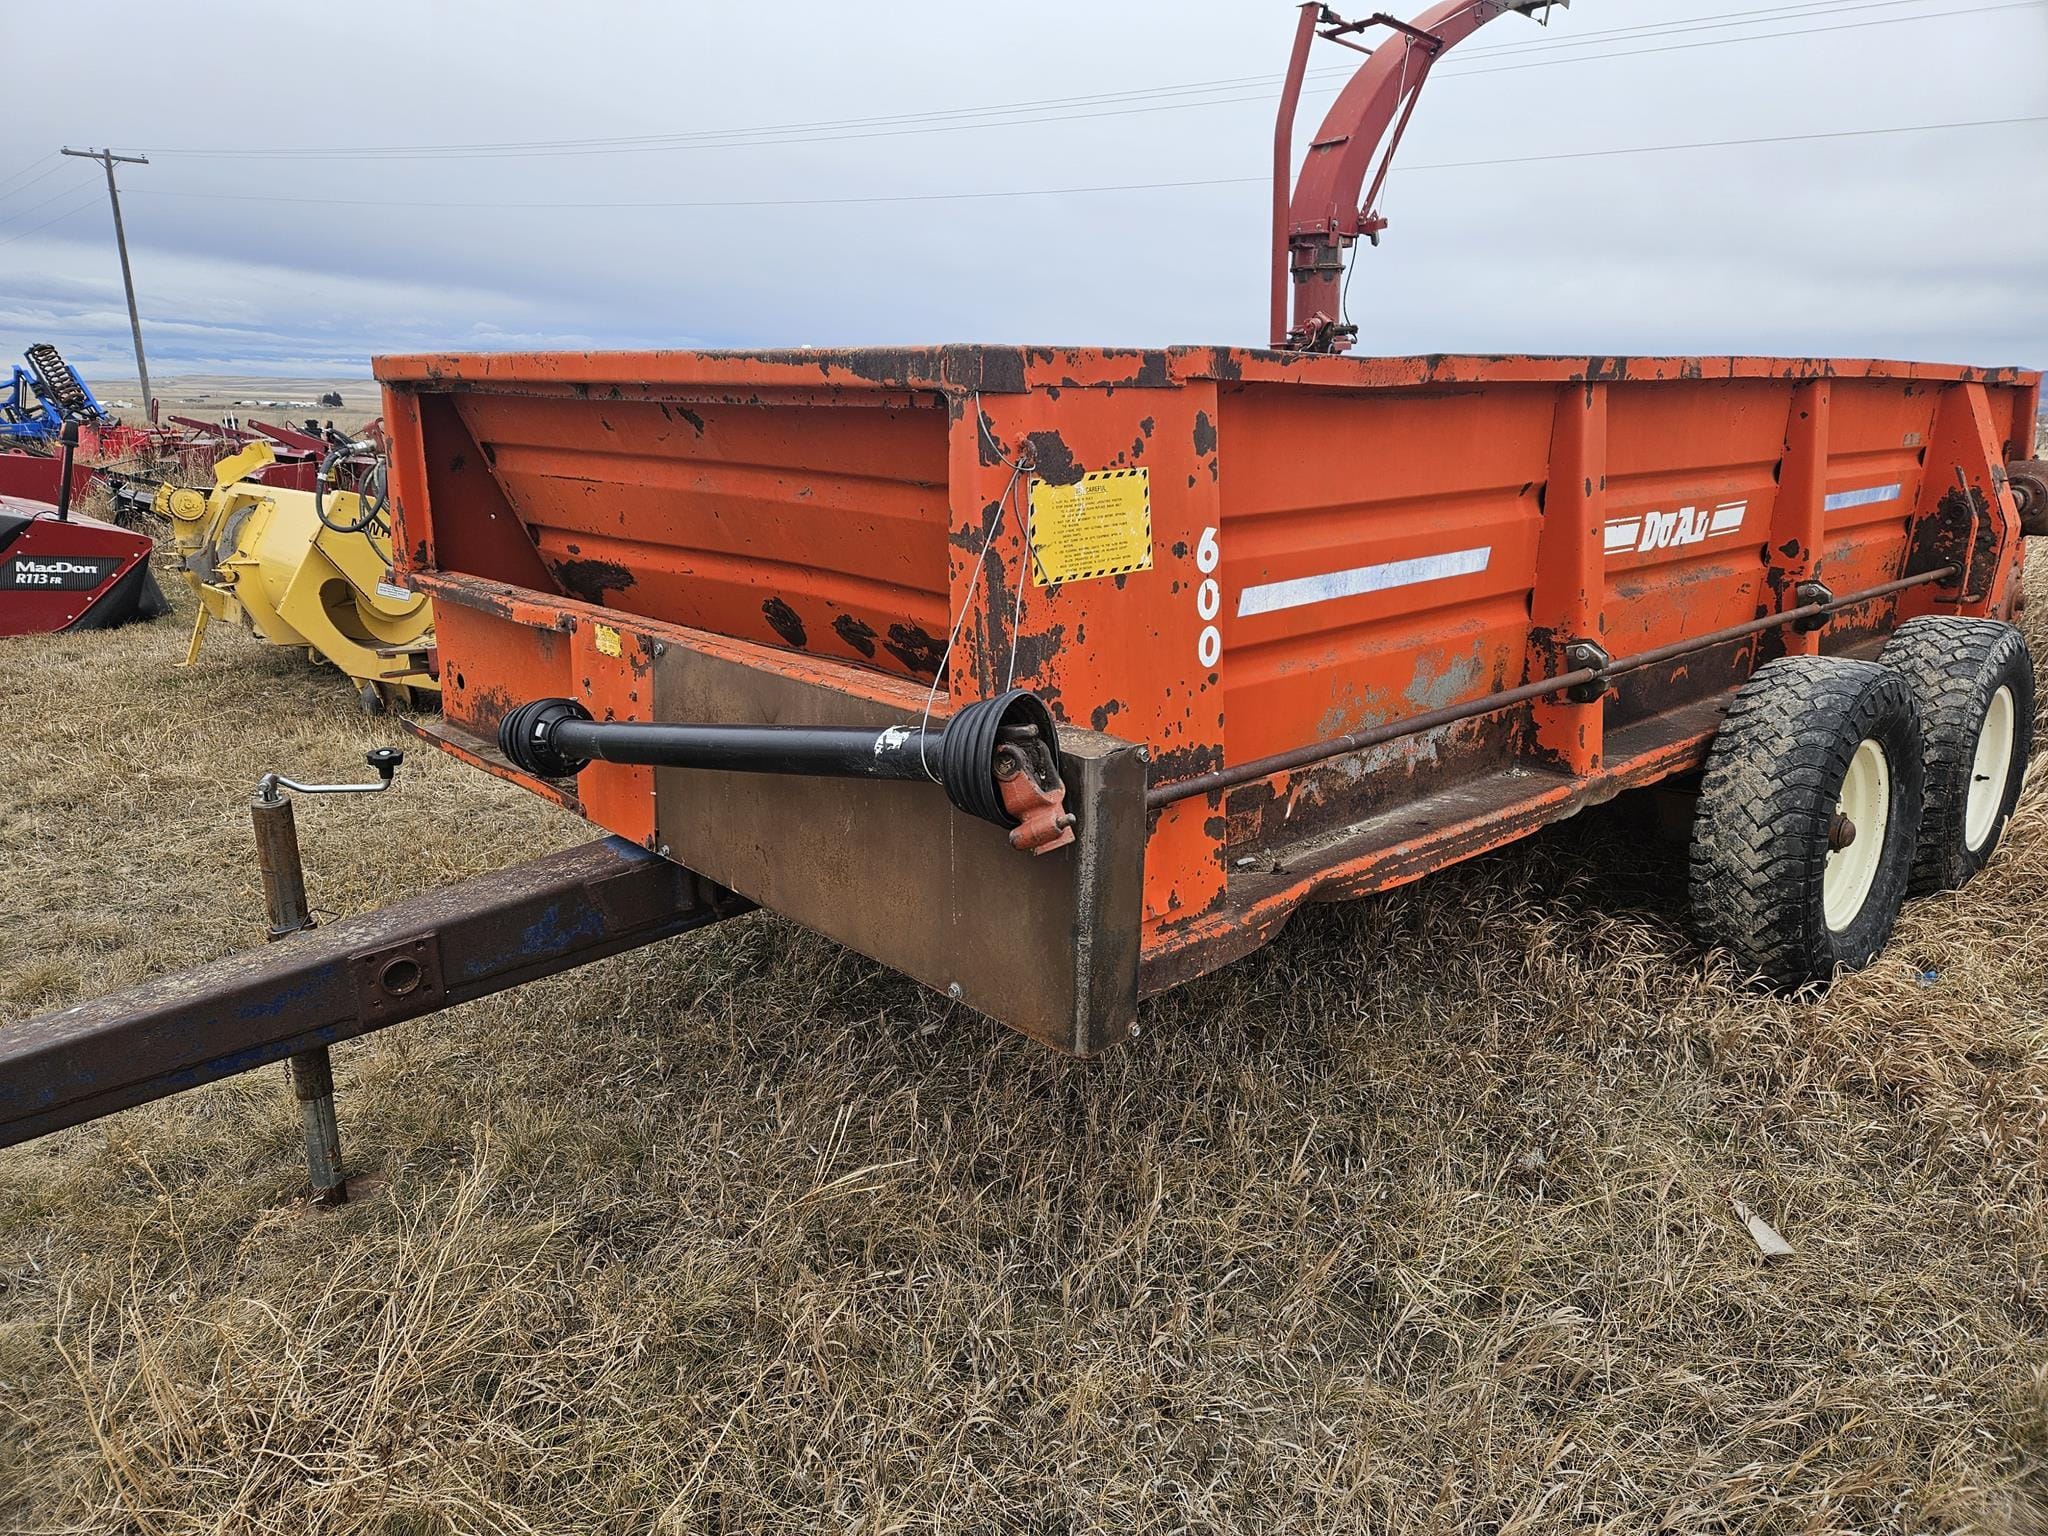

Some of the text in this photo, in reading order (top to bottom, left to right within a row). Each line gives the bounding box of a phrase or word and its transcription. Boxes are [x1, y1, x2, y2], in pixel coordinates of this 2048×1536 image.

[351, 518, 379, 536] NW
[15, 561, 98, 574] MacDon
[15, 574, 62, 585] R113 FR
[1196, 527, 1221, 668] 600
